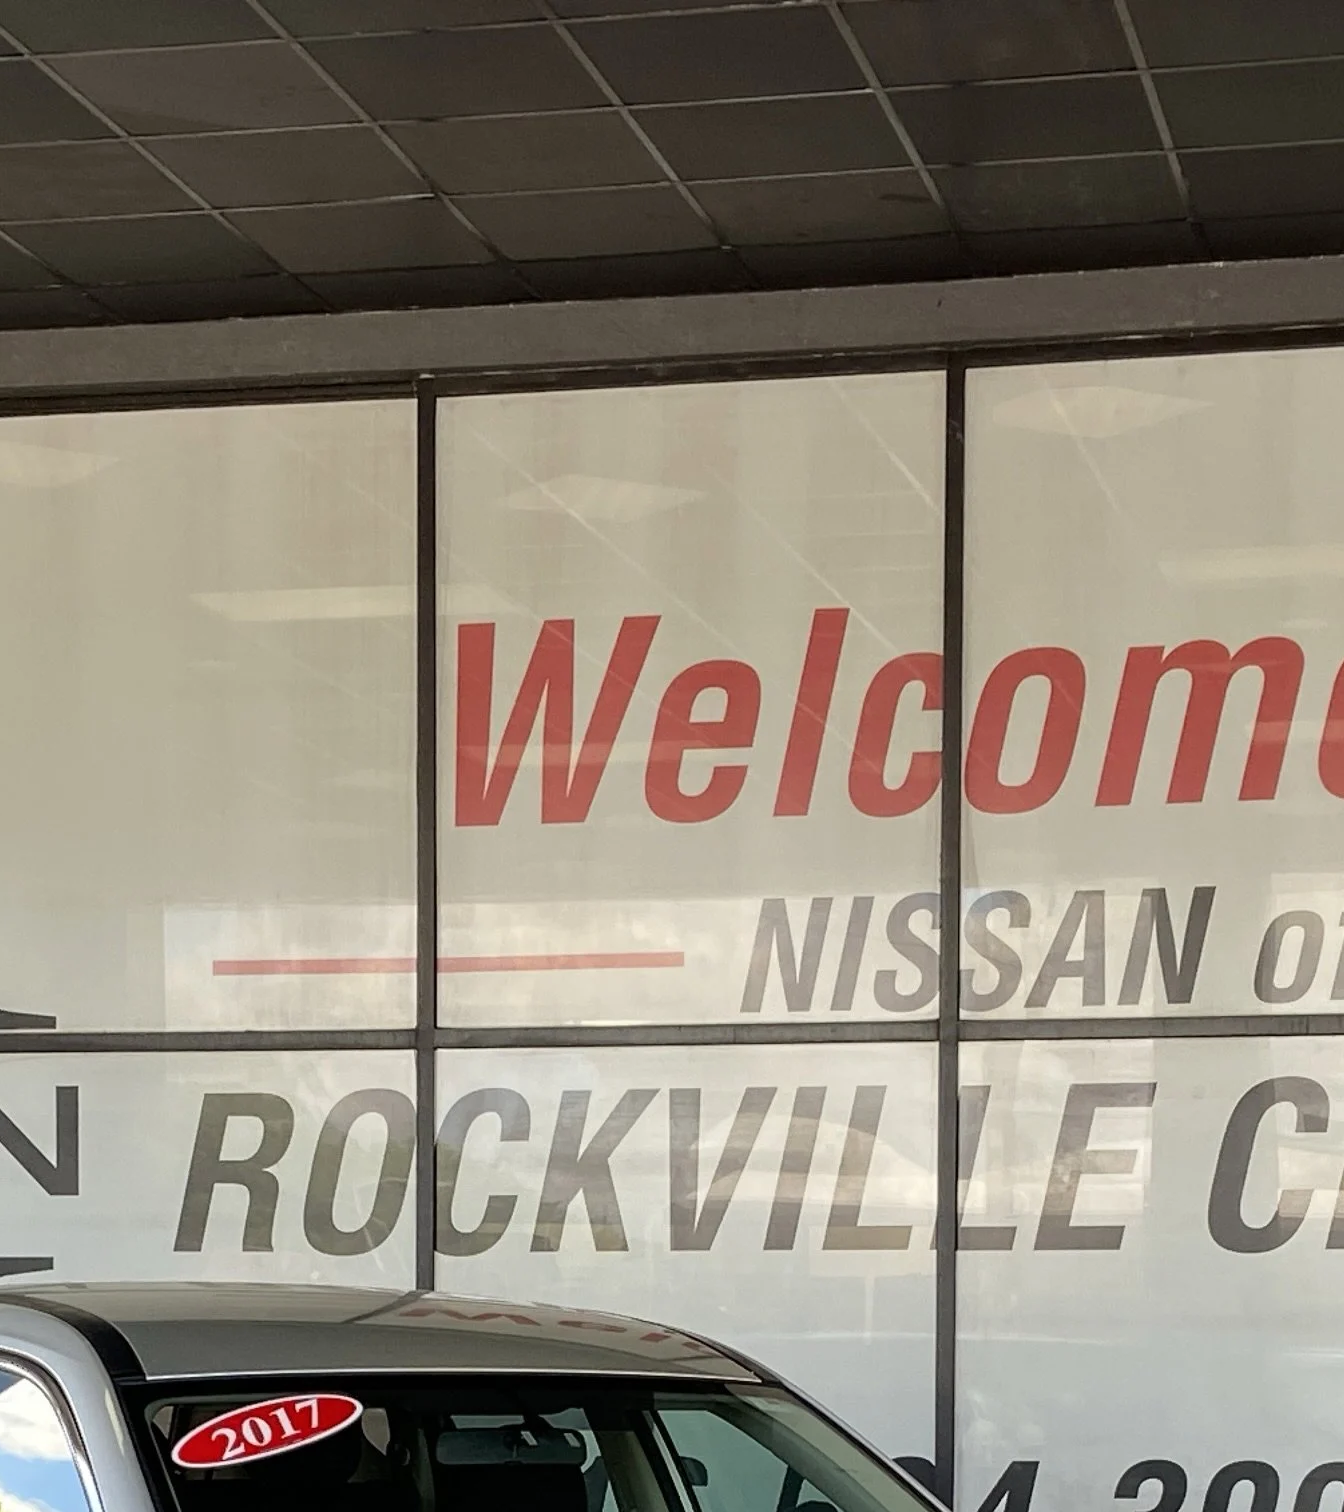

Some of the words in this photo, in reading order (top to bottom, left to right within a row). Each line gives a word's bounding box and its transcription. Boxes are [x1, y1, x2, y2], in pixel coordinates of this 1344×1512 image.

[740, 886, 1216, 1013] NISSAN
[173, 1083, 1158, 1256] ROCKVILLE
[211, 1398, 320, 1461] 2017
